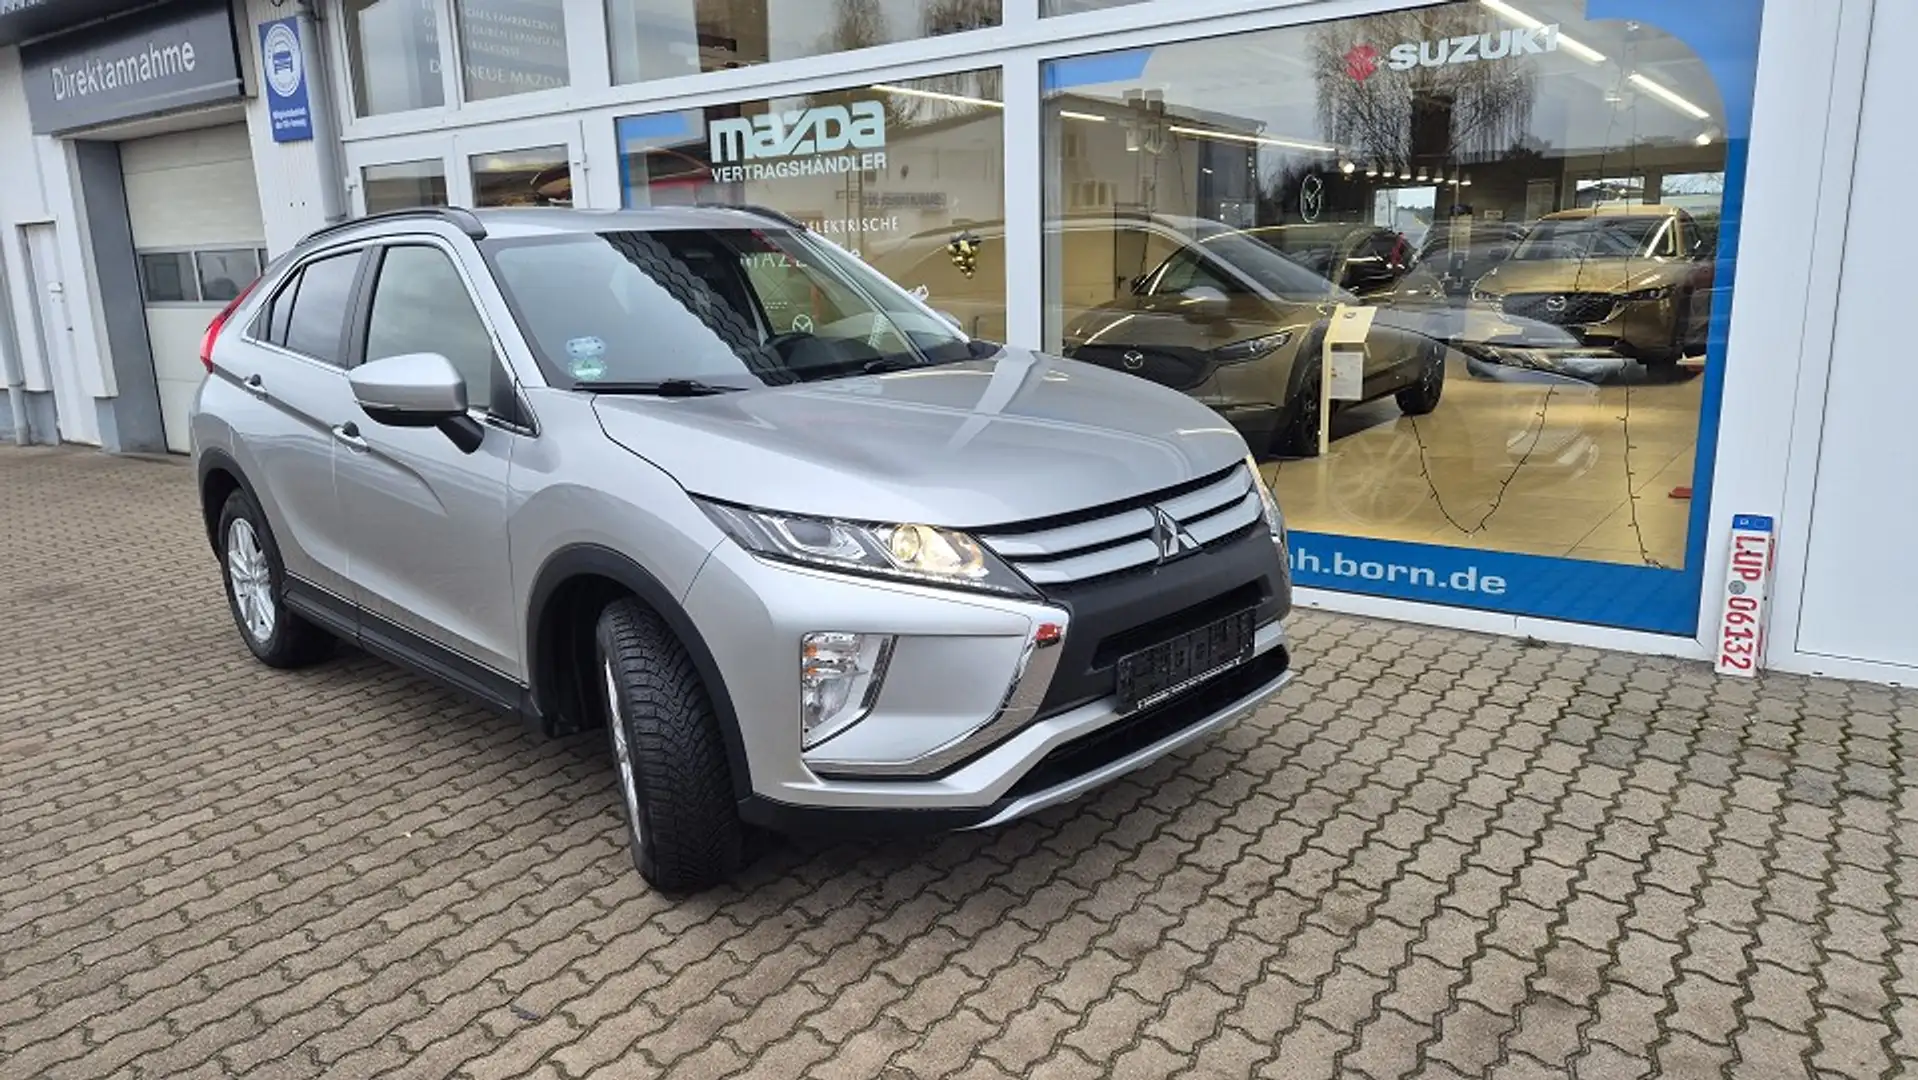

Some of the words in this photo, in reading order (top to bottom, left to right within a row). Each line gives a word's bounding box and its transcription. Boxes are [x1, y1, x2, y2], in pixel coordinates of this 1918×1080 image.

[51, 41, 196, 101] Direktannahme
[1388, 23, 1560, 72] SUZUKI
[711, 151, 887, 183] VERTRAGSHÄNDLER
[1732, 535, 1766, 582] LUP
[1721, 597, 1758, 670] 06132
